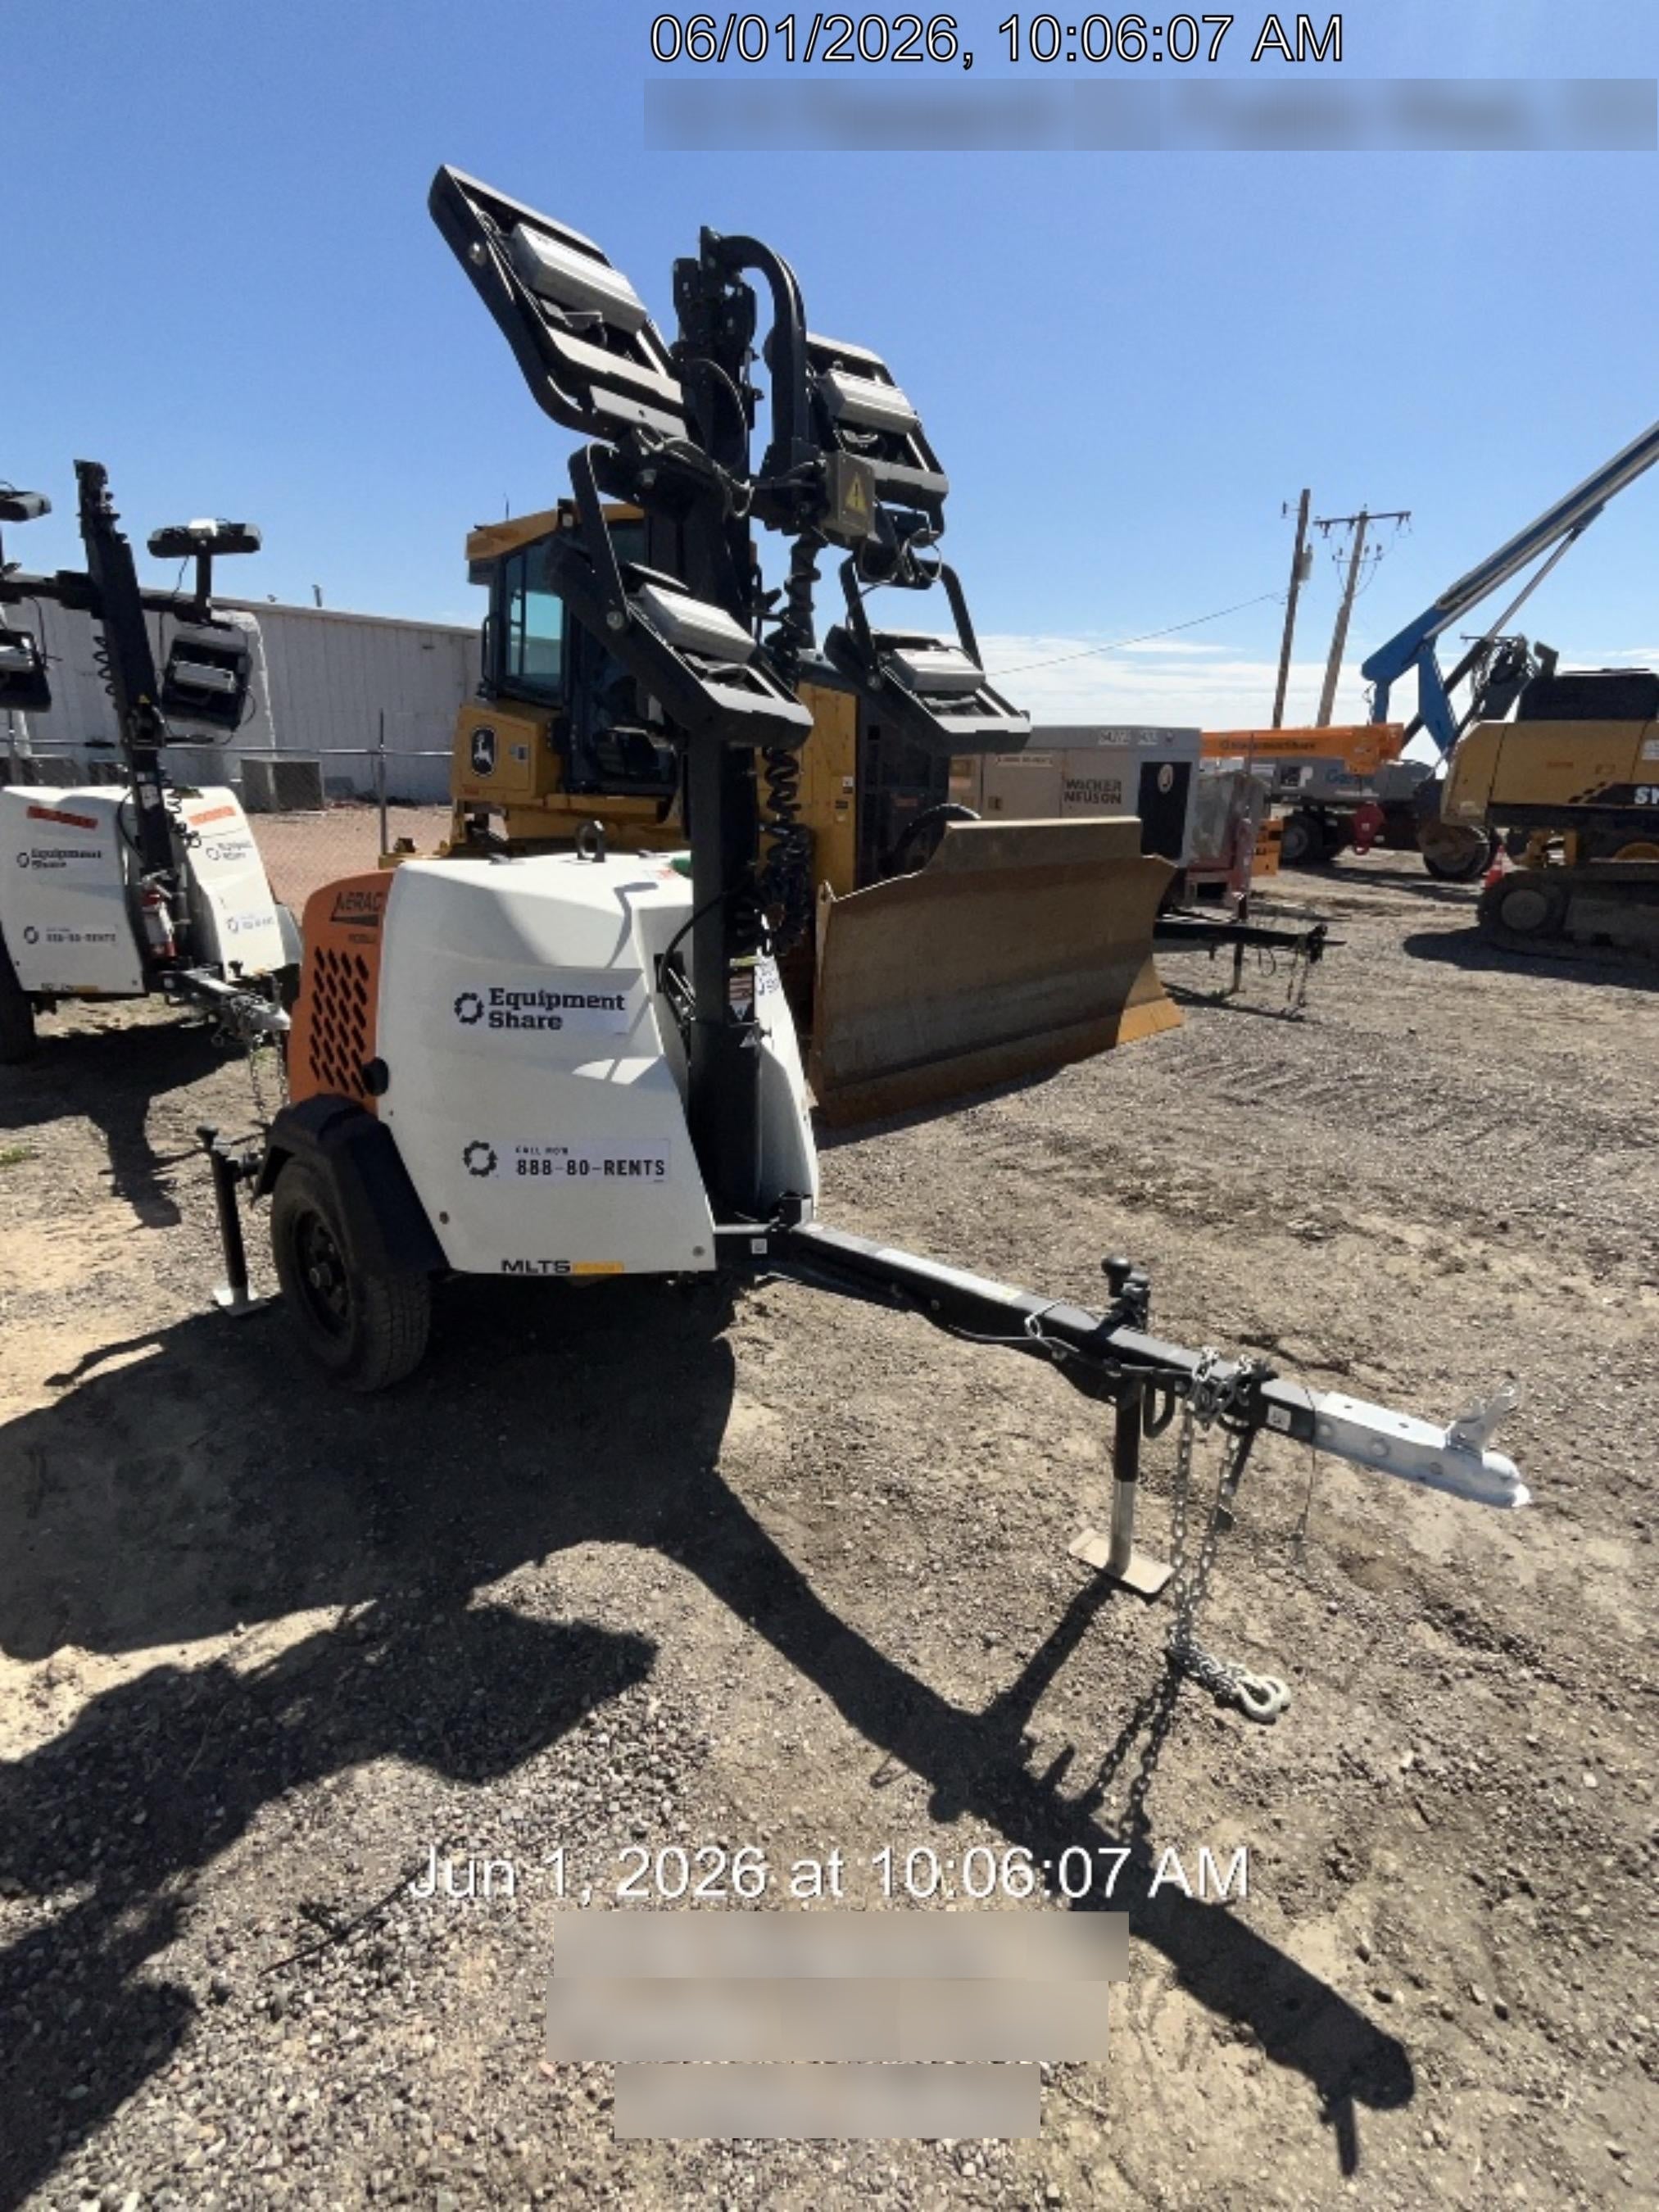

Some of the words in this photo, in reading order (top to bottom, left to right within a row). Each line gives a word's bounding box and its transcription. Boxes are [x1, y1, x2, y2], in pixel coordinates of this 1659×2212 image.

[488, 987, 626, 1011] Equipment
[488, 1010, 564, 1031] Share
[517, 1159, 665, 1176] 888-80-RENTS
